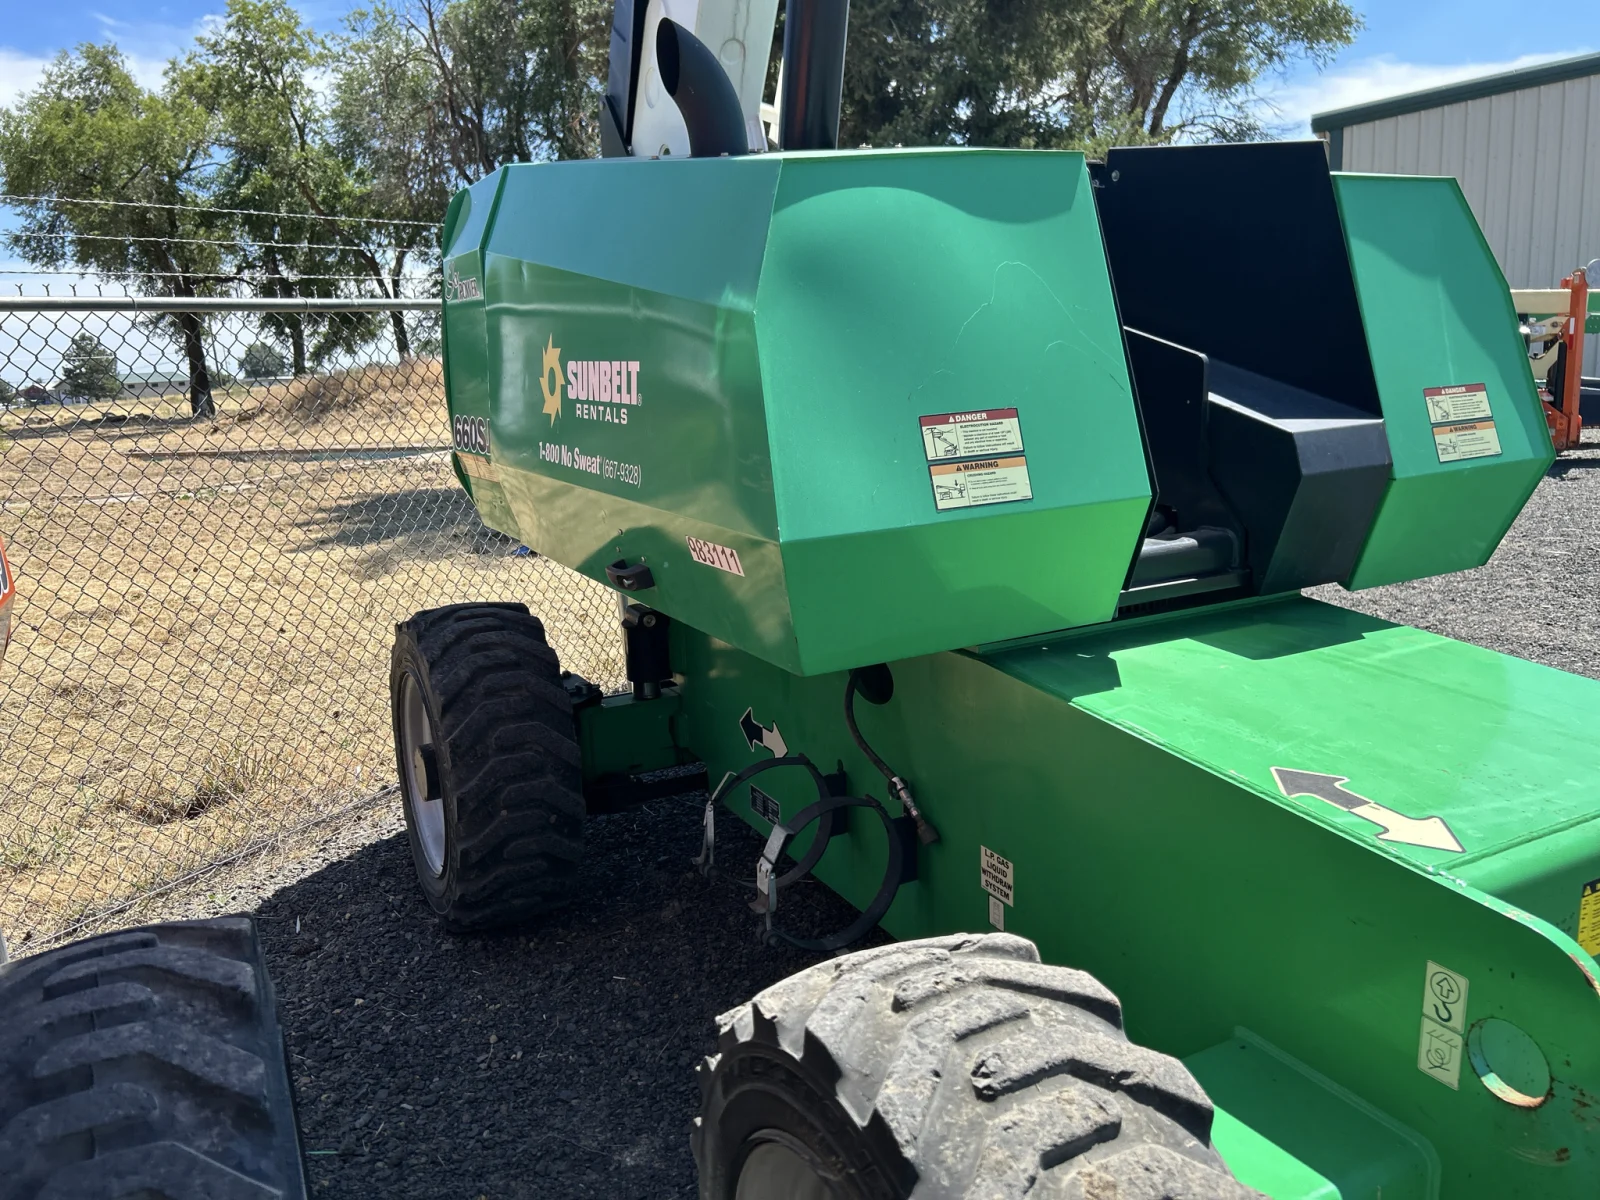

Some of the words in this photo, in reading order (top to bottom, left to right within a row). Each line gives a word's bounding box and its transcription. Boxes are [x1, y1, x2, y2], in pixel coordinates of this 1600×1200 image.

[567, 361, 640, 405] SUNBELT
[576, 403, 628, 424] RENTALS
[955, 413, 987, 422] DANGER
[539, 441, 560, 464] 1-800
[561, 444, 572, 468] No
[602, 457, 642, 488] (667-9328)
[962, 461, 999, 471] WARNING
[688, 537, 741, 574] 983111
[986, 860, 1008, 878] LIQUID
[996, 856, 1010, 870] GAS
[981, 867, 1013, 892] WITHDRAW
[985, 880, 1010, 901] SYSTEM
